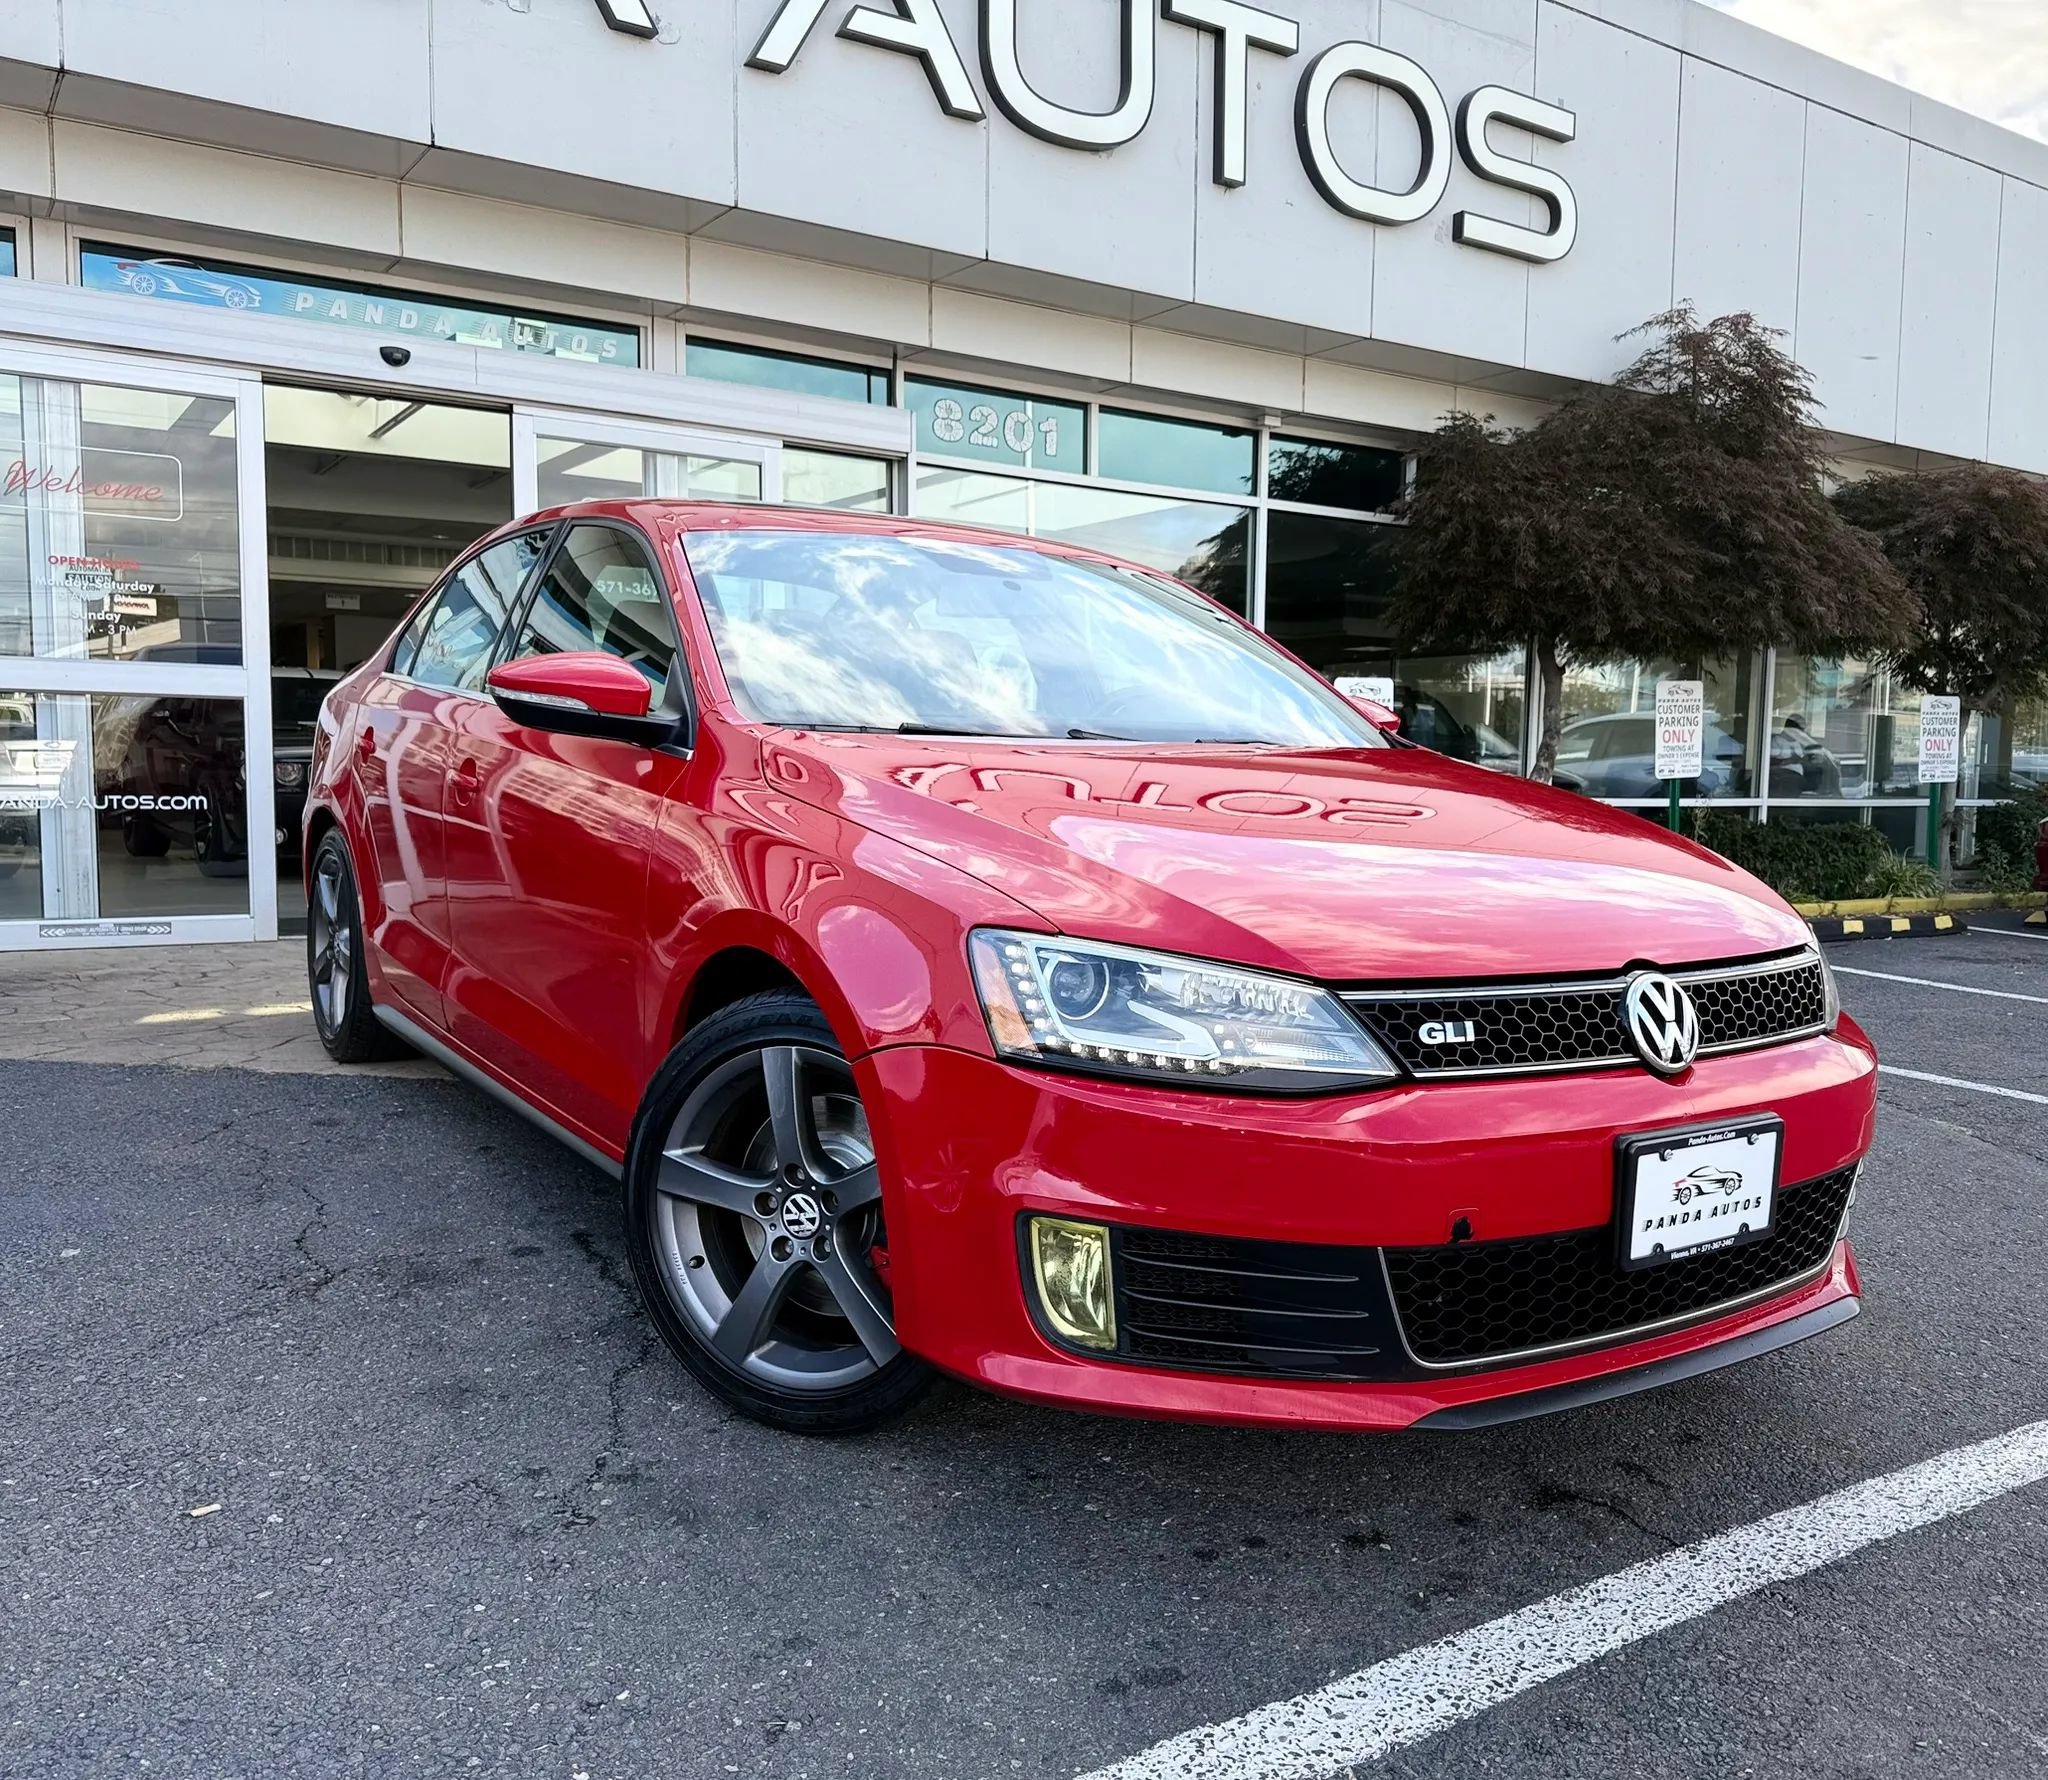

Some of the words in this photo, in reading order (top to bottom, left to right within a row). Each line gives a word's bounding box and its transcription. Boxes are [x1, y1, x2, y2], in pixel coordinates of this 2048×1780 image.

[295, 292, 451, 334] PANDA
[480, 320, 617, 359] AUTOS
[932, 398, 1057, 457] 8201
[3, 460, 164, 501] Welcome
[48, 555, 86, 568] OPEN
[1657, 704, 1700, 715] CUSTOMER
[1659, 716, 1699, 727] PARKING
[1921, 716, 1957, 726] CUSTOMER
[1662, 729, 1695, 744] ONLY
[1922, 727, 1956, 738] PARKING
[1925, 739, 1953, 752] ONLY
[1418, 1020, 1475, 1045] GLI
[1643, 1210, 1702, 1232] PANDA
[1711, 1196, 1762, 1218] AUTOS
